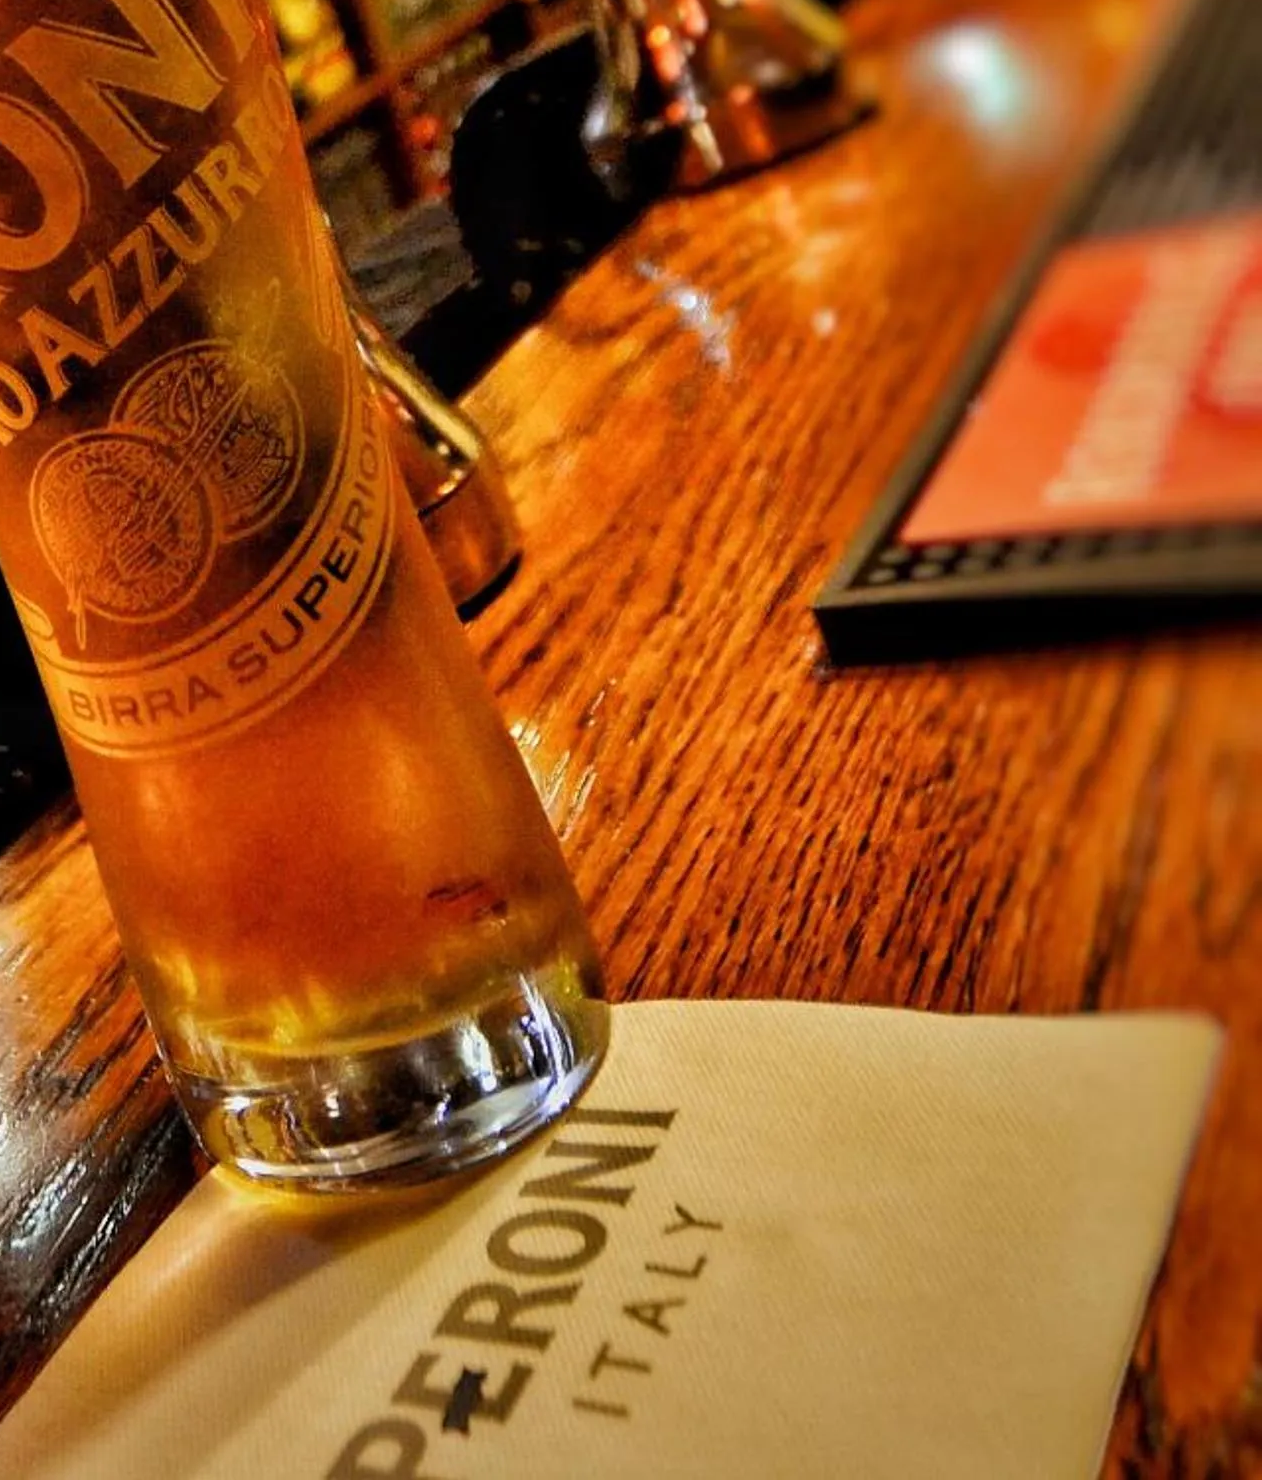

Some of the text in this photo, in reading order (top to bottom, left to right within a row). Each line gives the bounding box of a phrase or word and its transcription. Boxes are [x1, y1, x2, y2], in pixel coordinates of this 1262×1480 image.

[68, 676, 223, 727] BIRRA
[323, 1107, 679, 1480] PERONI
[572, 1203, 724, 1418] ITALY
